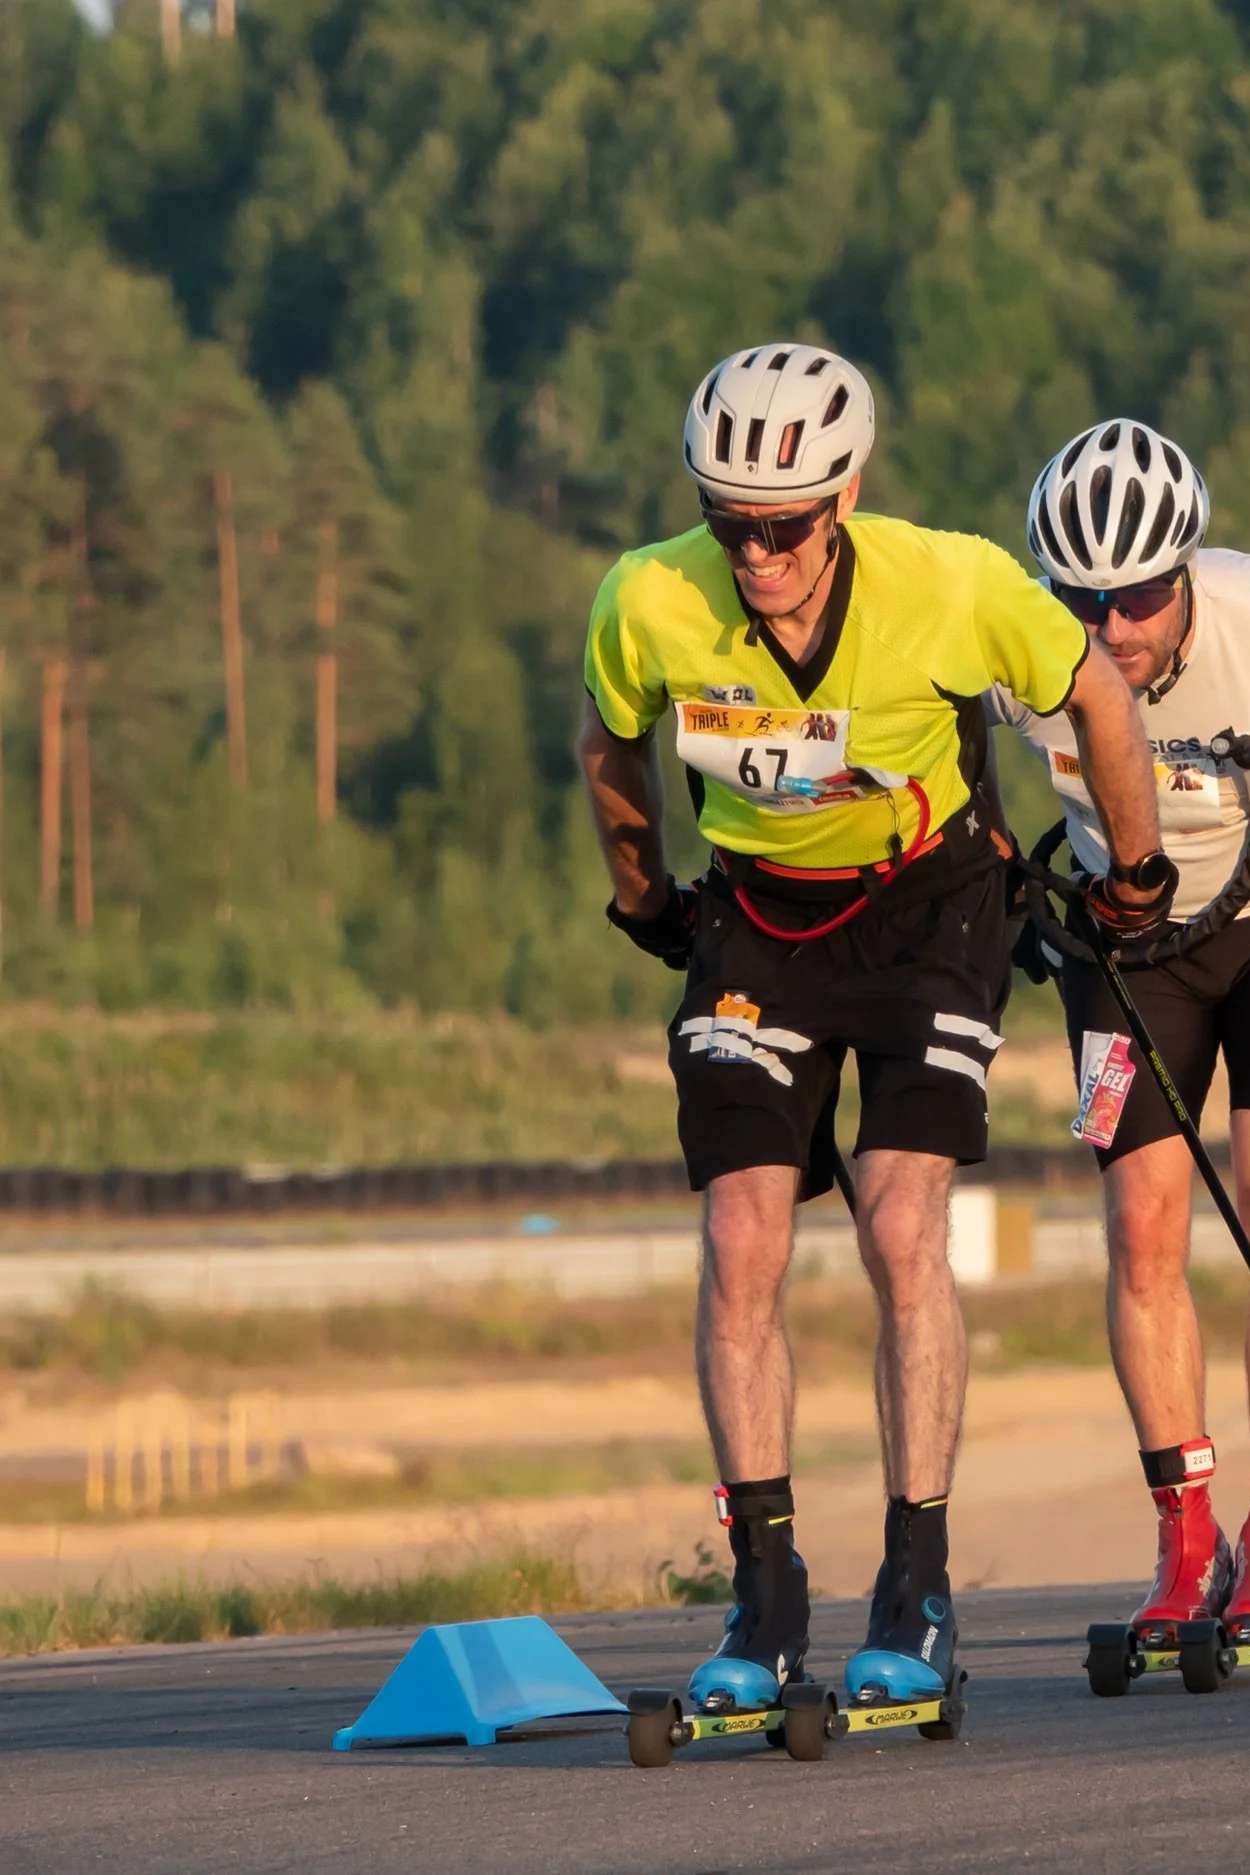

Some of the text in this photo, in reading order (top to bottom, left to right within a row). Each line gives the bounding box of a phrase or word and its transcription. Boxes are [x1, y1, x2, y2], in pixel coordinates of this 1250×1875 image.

[692, 711, 729, 731] TRIPLE
[1149, 736, 1202, 754] SICS
[738, 747, 789, 792] 67
[1100, 1068, 1132, 1092] GEL
[921, 1624, 939, 1663] SALOMON
